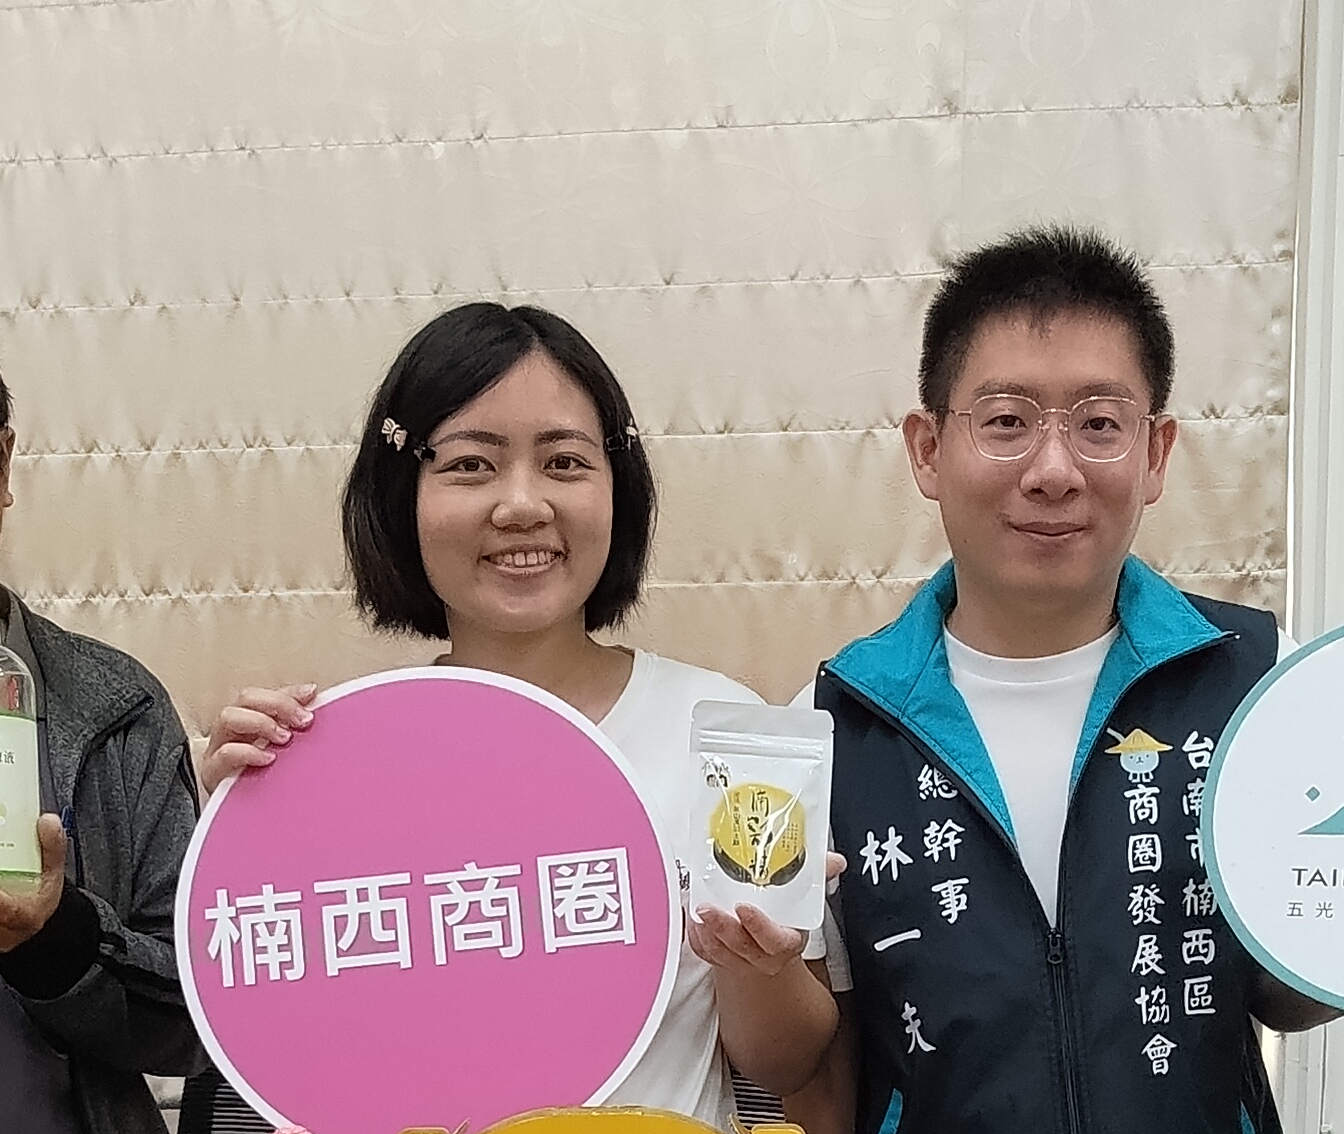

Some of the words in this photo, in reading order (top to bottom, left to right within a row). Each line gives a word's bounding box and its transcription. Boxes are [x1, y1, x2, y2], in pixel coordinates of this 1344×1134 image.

[204, 847, 637, 988] 楠西商圈
[918, 764, 970, 925] 總幹事
[1126, 784, 1177, 1076] 商圈發展協會
[859, 831, 937, 1054] 林一夫
